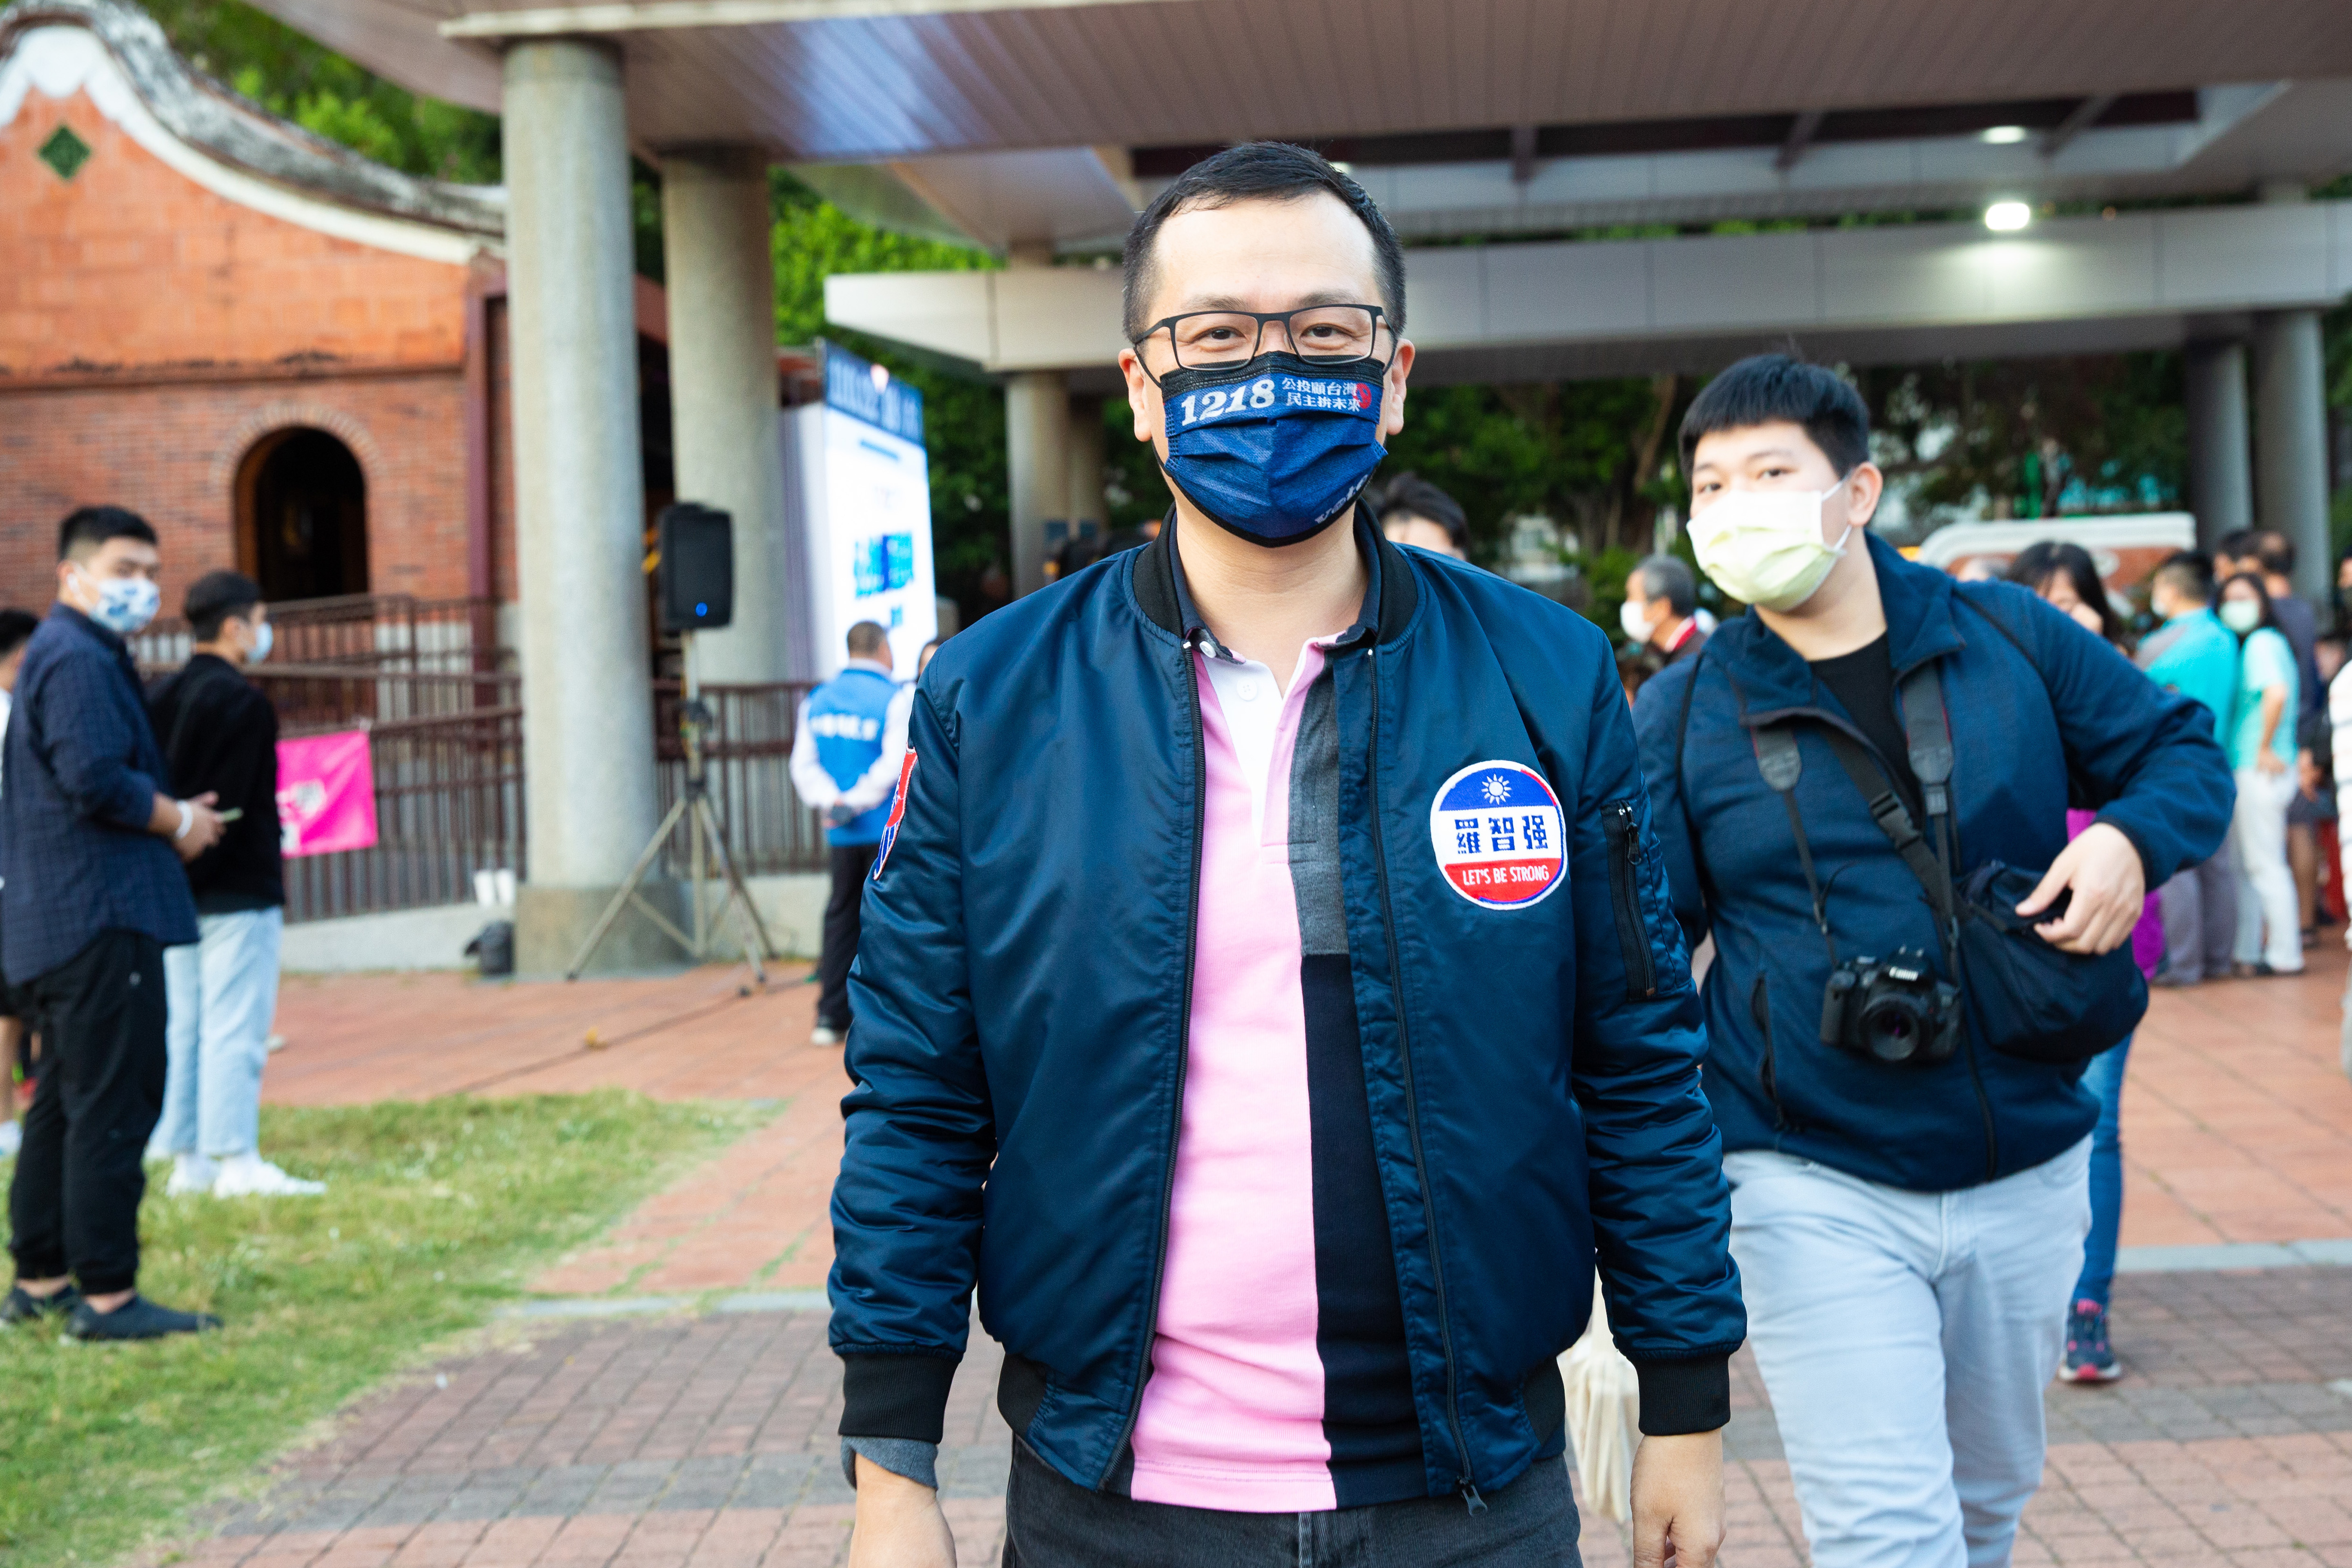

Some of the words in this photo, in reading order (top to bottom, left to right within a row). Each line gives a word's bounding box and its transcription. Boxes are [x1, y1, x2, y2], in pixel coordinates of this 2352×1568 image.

[1181, 379, 1275, 426] 1218
[1462, 869, 1491, 886] LET'S
[1493, 867, 1508, 884] BE
[1510, 864, 1550, 882] STRONG
